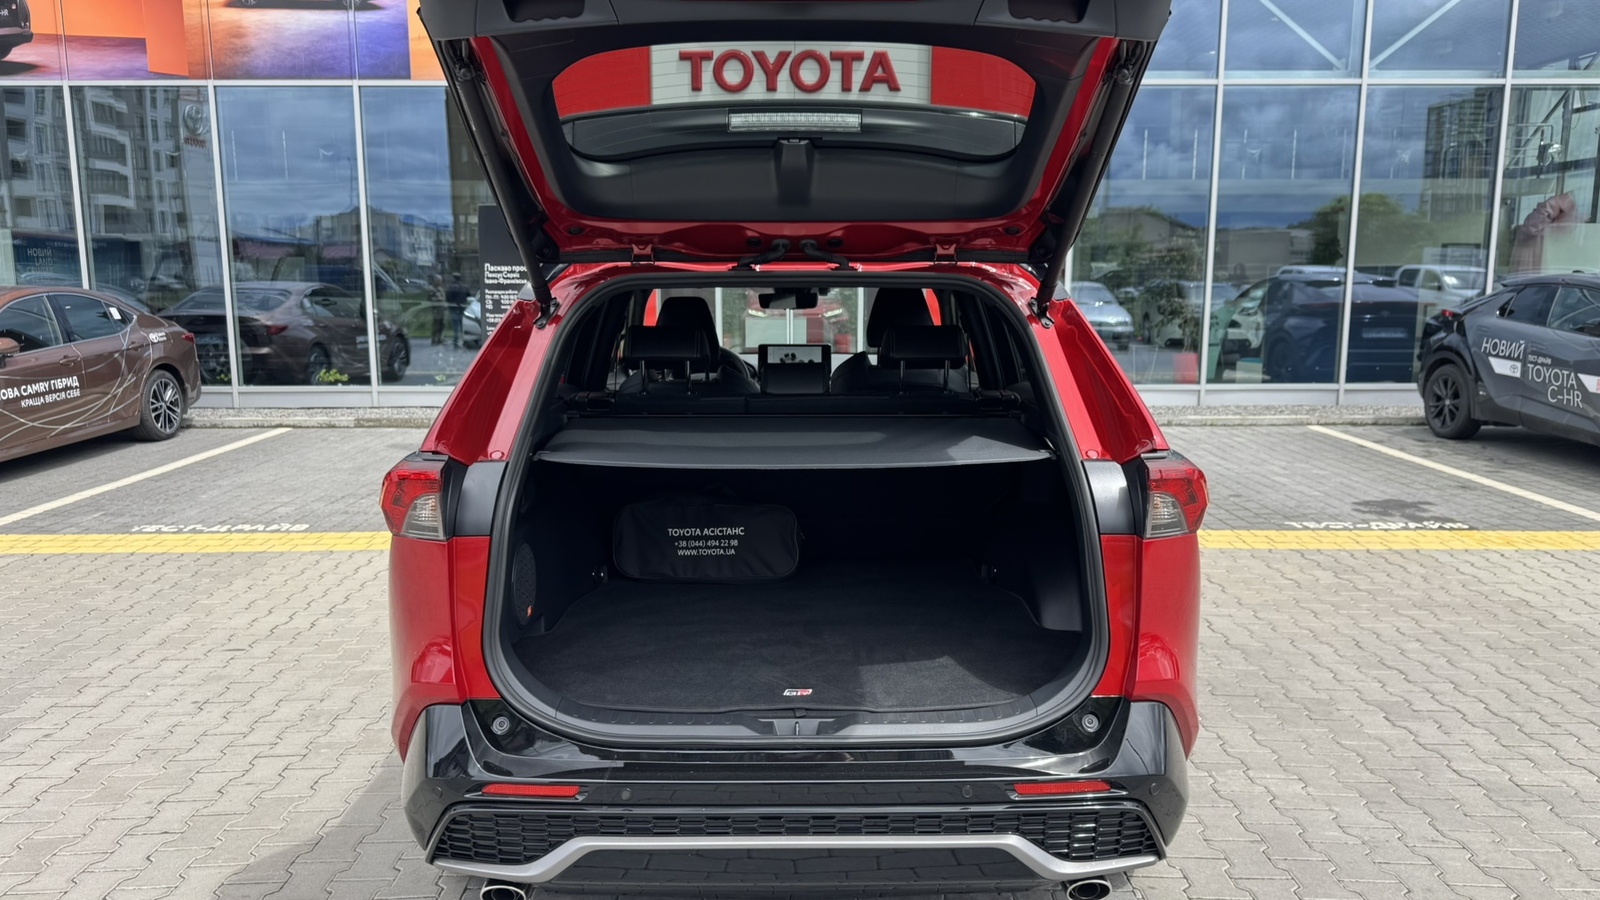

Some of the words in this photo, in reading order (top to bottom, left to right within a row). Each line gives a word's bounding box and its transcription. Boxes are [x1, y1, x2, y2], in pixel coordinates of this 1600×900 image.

[679, 49, 901, 93] TOYOTA
[27, 247, 52, 257] НОВИЙ
[35, 258, 53, 266] LAND
[1481, 337, 1525, 359] НОВИЙ
[1527, 364, 1577, 389] TOYOTA
[0, 386, 20, 400] ОВА
[20, 381, 51, 396] CAMRY
[51, 375, 80, 391] ГІБРИД
[1548, 386, 1583, 408] C-HR
[20, 397, 45, 408] КРАЩА
[45, 392, 66, 403] ВЕРСІЯ
[66, 388, 81, 399] СЕБЕ
[667, 528, 702, 536] TOYOTA
[702, 527, 745, 536] АСІСТАНС
[677, 548, 736, 556] WWW.TOYOTA.UA
[688, 540, 706, 548] (044)
[706, 539, 720, 547] 494
[720, 539, 729, 547] 22
[729, 539, 739, 547] 98
